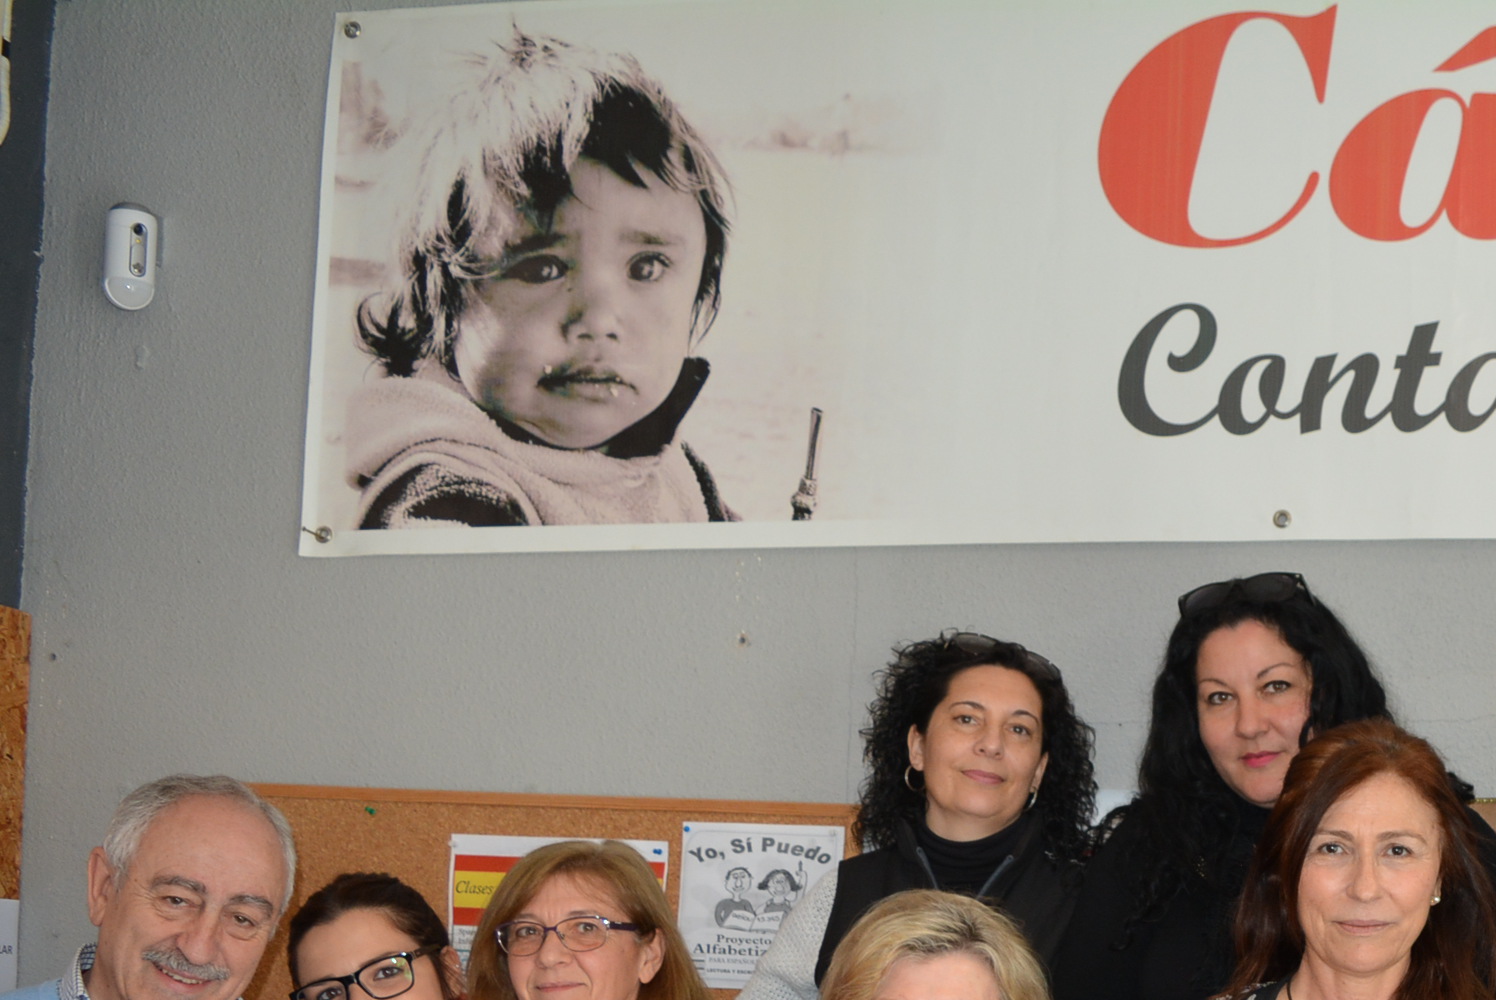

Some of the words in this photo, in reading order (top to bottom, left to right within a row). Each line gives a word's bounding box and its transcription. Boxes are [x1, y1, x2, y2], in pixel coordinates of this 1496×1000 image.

[688, 846, 726, 863] Yo,
[730, 837, 753, 854] Sí
[761, 836, 832, 864] Puedo
[455, 879, 494, 895] Clases
[716, 933, 772, 946] Proyecto
